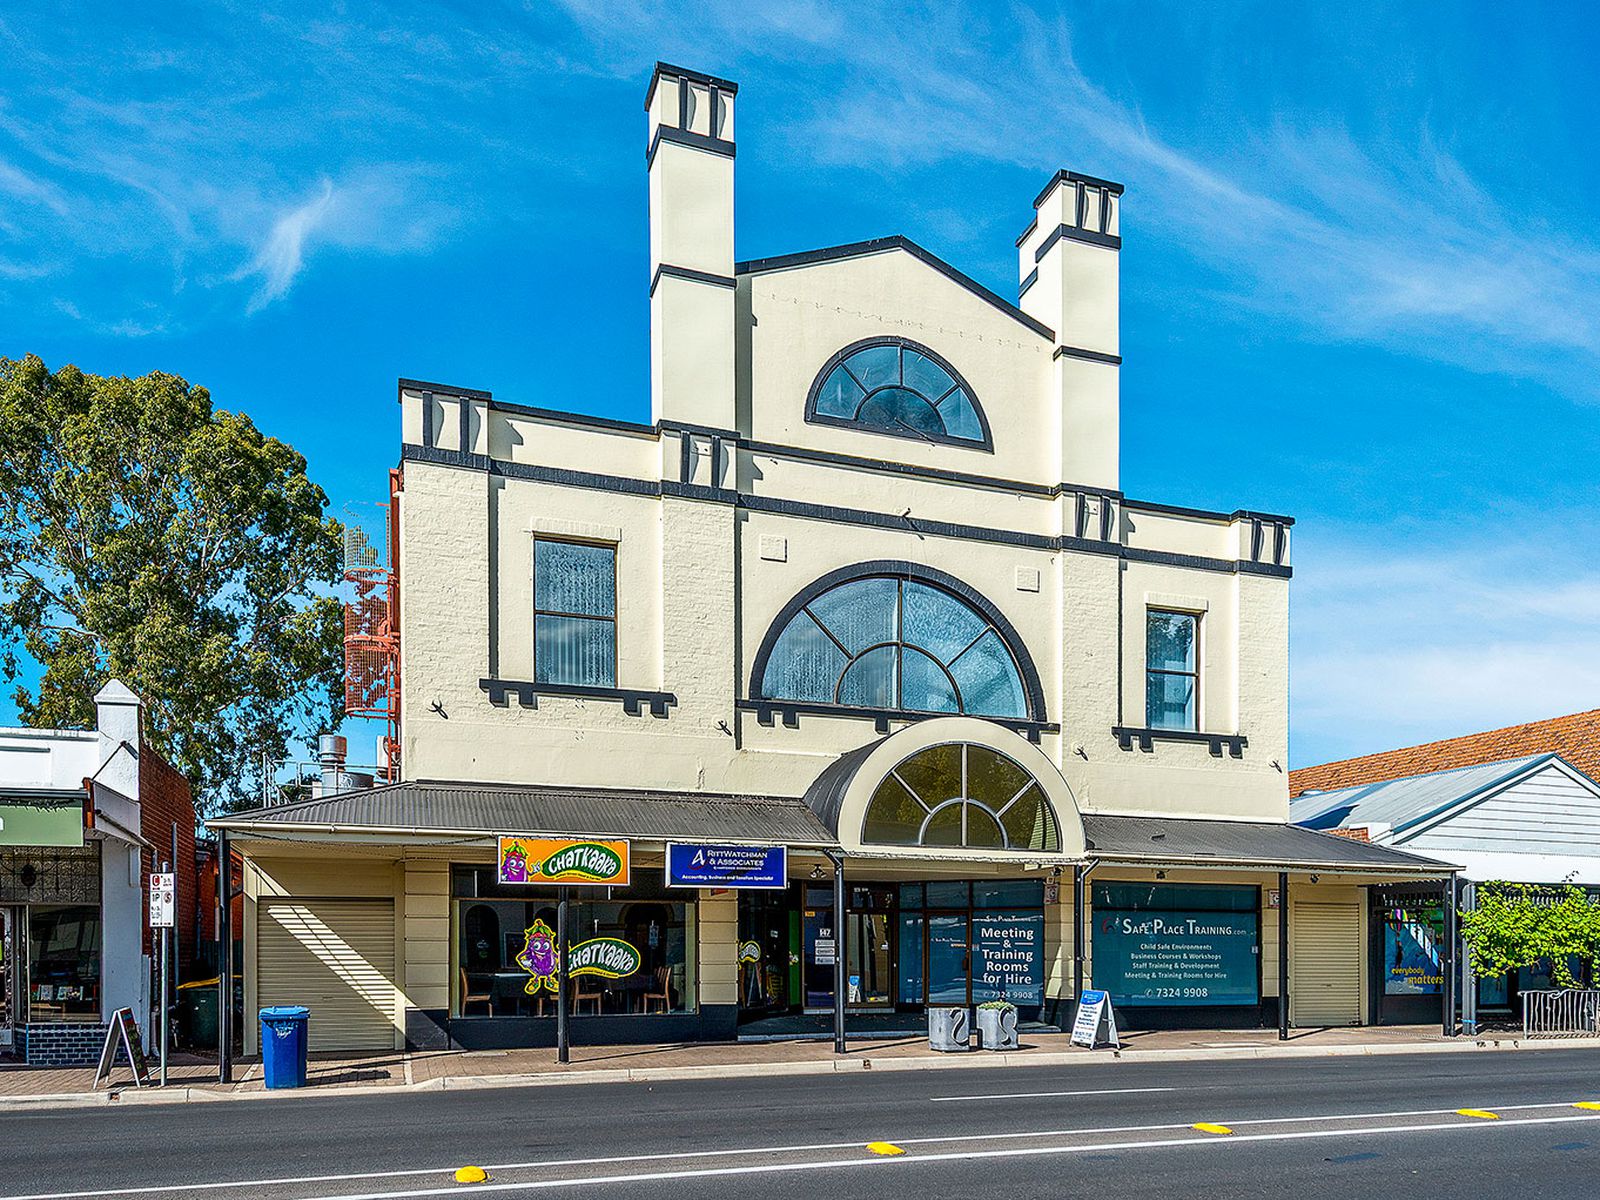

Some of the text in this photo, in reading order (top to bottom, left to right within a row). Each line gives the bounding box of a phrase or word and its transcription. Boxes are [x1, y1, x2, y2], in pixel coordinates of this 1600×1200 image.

[717, 858, 764, 867] ASSOCIATES
[1122, 918, 1149, 935] SAFE
[1153, 919, 1185, 935] PLACE
[981, 928, 1034, 940] Meeting
[1003, 939, 1012, 948] &
[982, 949, 1034, 962] Training
[986, 961, 1029, 972] Rooms
[1391, 965, 1425, 976] everybody
[983, 972, 1032, 984] for Hire
[1407, 975, 1445, 985] matters
[991, 991, 1033, 999] 7324 9908
[1156, 988, 1208, 998] 7324 9908
